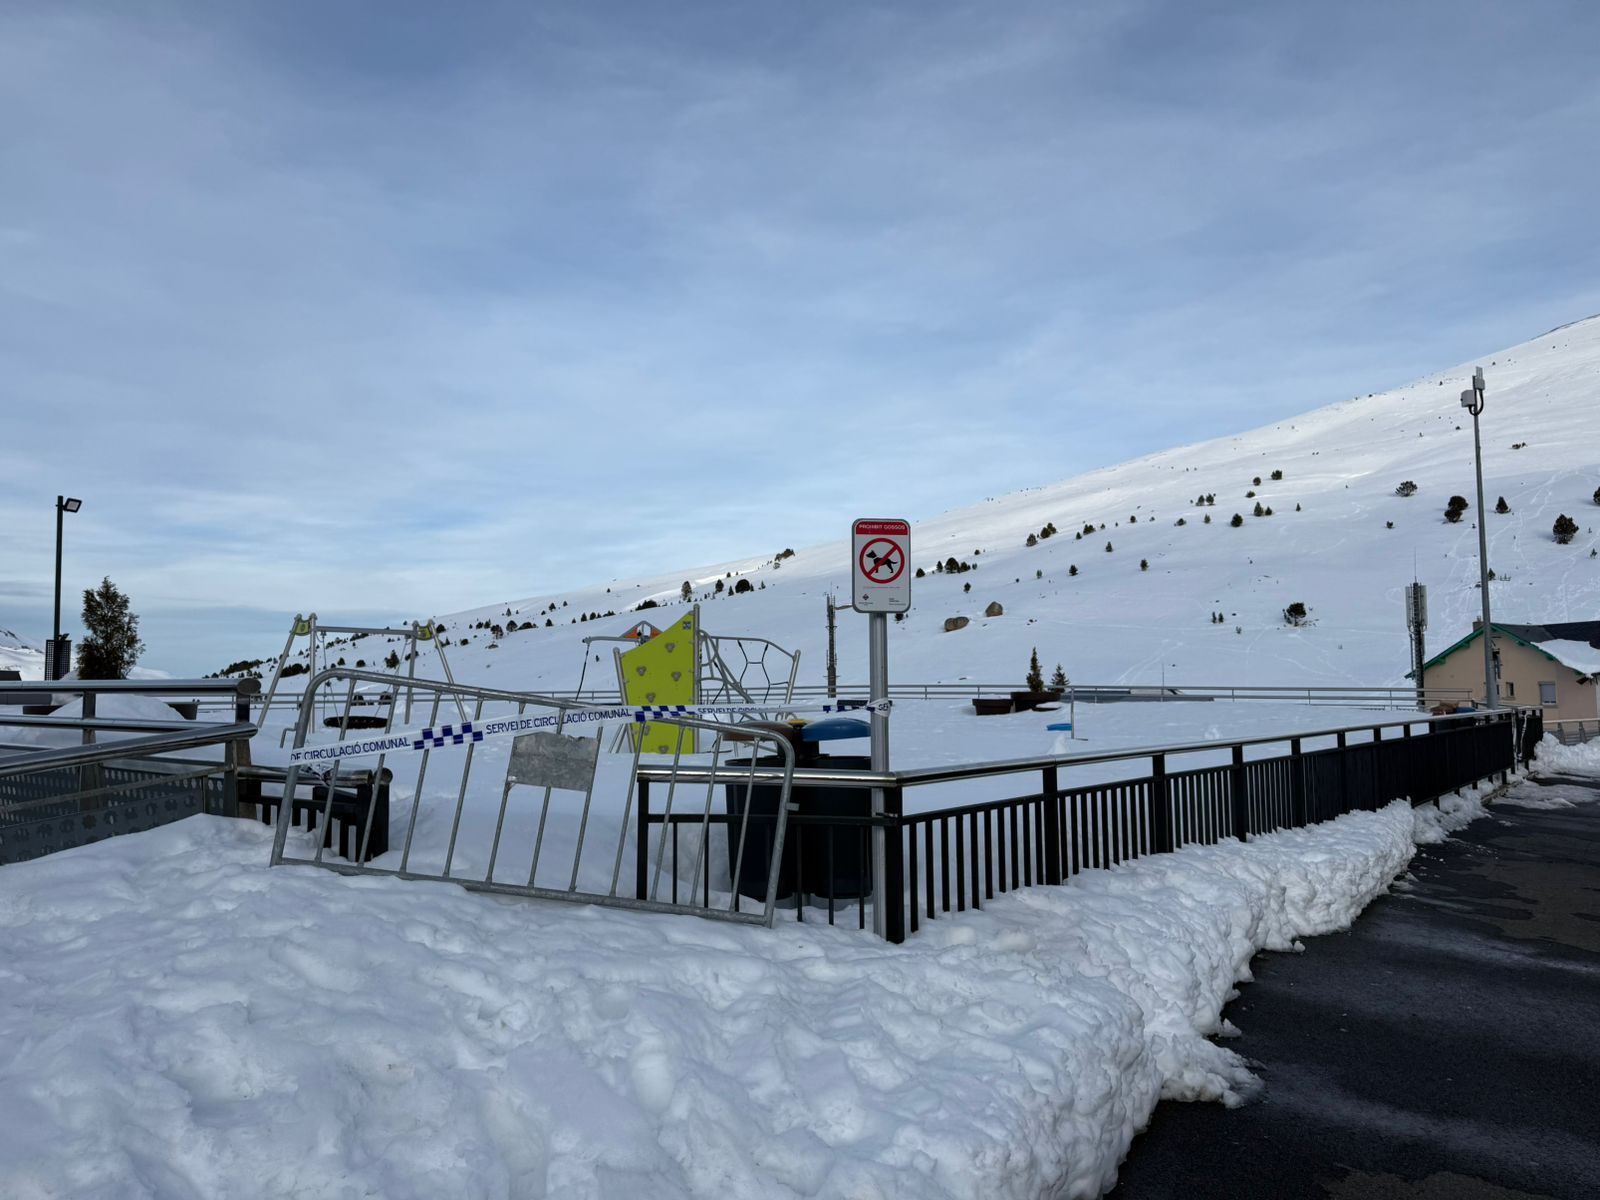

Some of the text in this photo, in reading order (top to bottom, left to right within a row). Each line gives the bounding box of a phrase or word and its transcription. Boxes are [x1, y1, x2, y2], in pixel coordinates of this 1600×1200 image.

[485, 721, 519, 734] SERVEI
[520, 717, 532, 729] DE
[588, 708, 632, 721] COMUNAL
[304, 741, 362, 761] CIRCULACIÓ
[362, 737, 411, 753] COMUNAL
